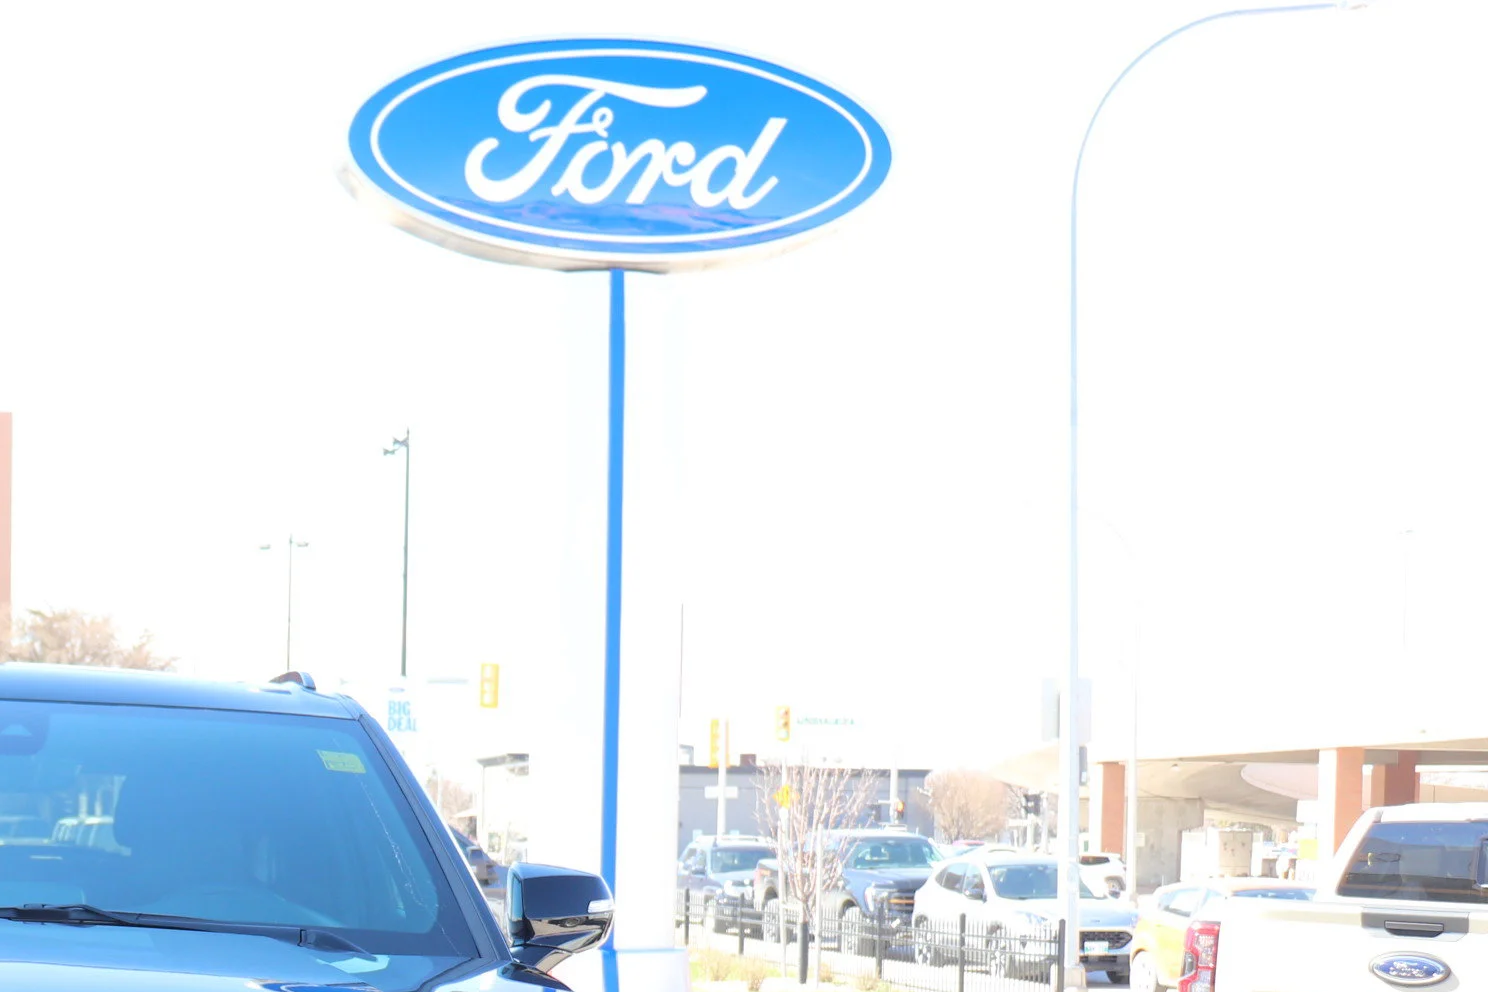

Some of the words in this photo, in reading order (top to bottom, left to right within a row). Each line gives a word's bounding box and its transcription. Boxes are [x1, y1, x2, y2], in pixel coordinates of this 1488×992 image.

[464, 74, 787, 210] Ford
[389, 701, 411, 716] BIG
[388, 717, 417, 732] DEAL
